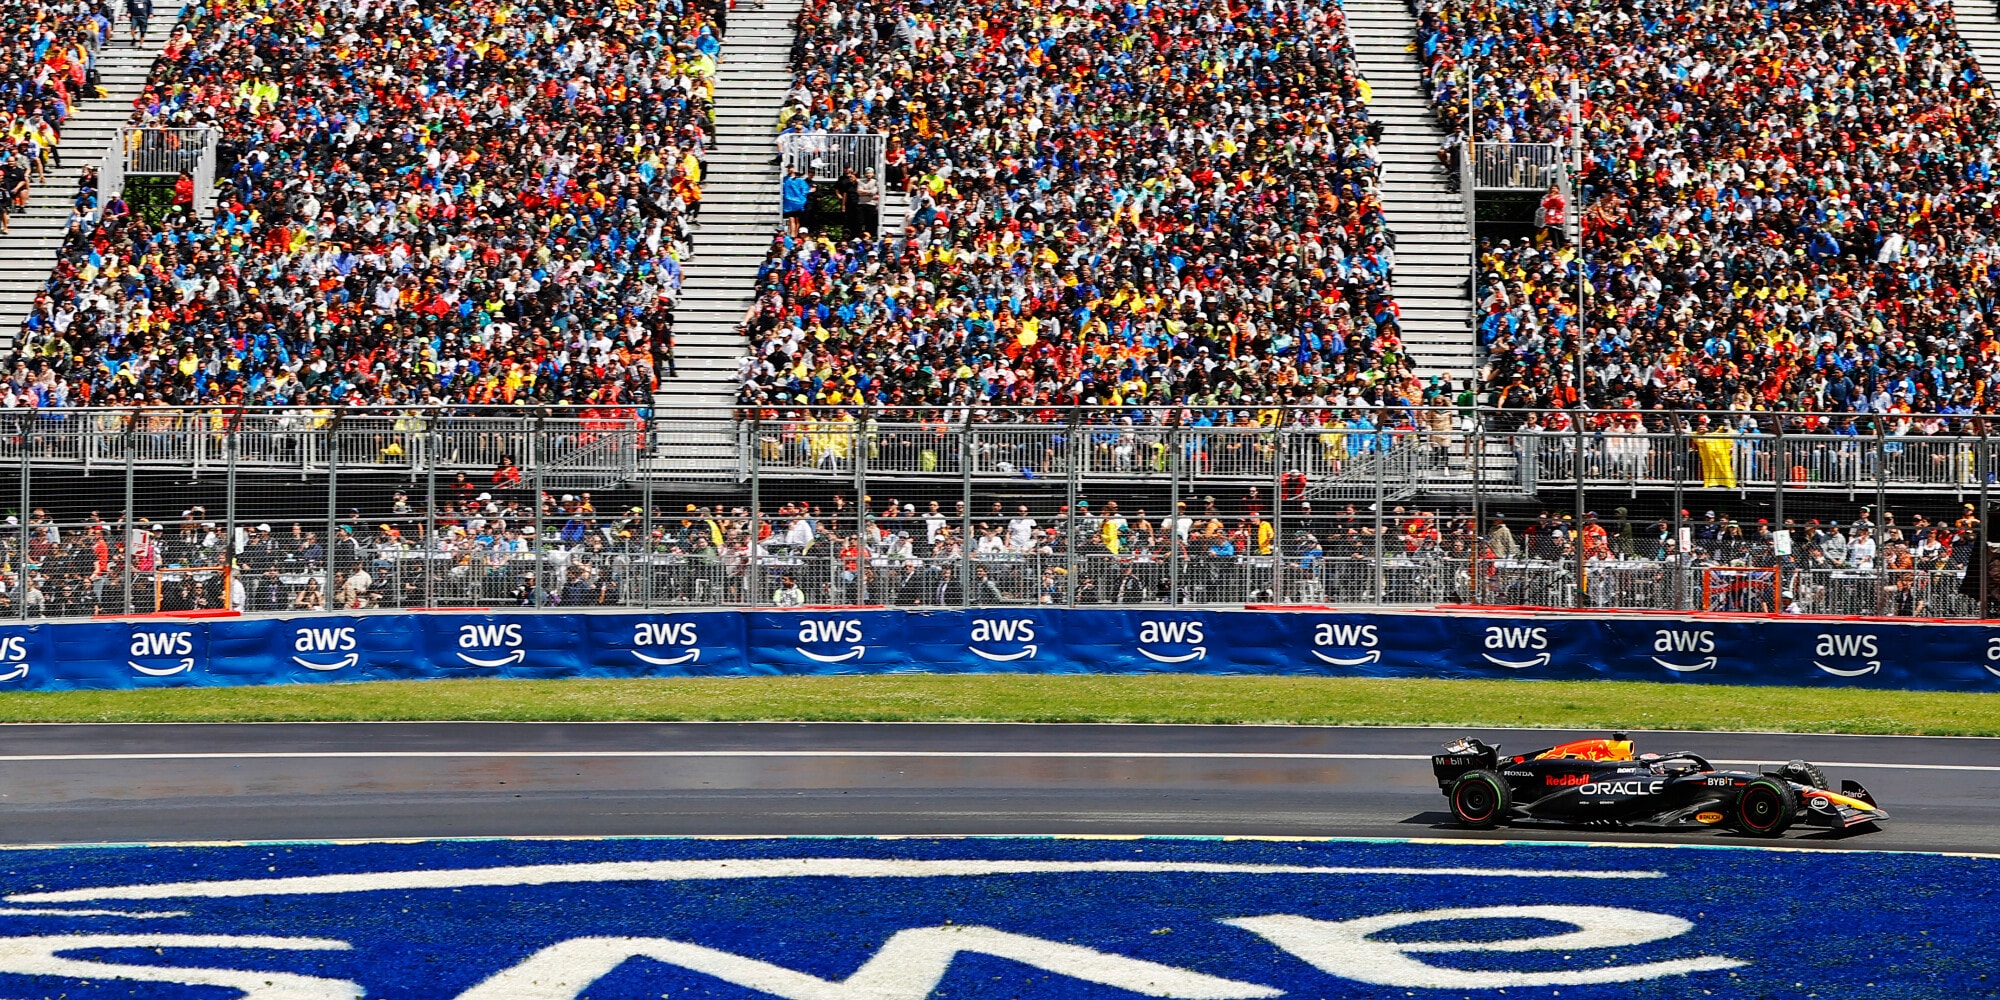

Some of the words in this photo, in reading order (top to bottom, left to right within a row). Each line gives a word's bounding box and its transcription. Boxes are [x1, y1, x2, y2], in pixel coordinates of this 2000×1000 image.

[295, 627, 357, 652] aws
[459, 624, 523, 647] aws
[634, 622, 698, 645] aws
[799, 619, 863, 642] aws
[971, 619, 1035, 642] aws
[1140, 620, 1204, 643] aws
[1315, 624, 1379, 646] aws
[1485, 627, 1548, 649] aws
[1655, 630, 1715, 652] aws
[131, 632, 193, 657] aws
[1816, 634, 1878, 657] aws
[1435, 757, 1463, 766] Mobil
[1579, 780, 1664, 795] ORACLE
[1707, 776, 1734, 786] BYBIT
